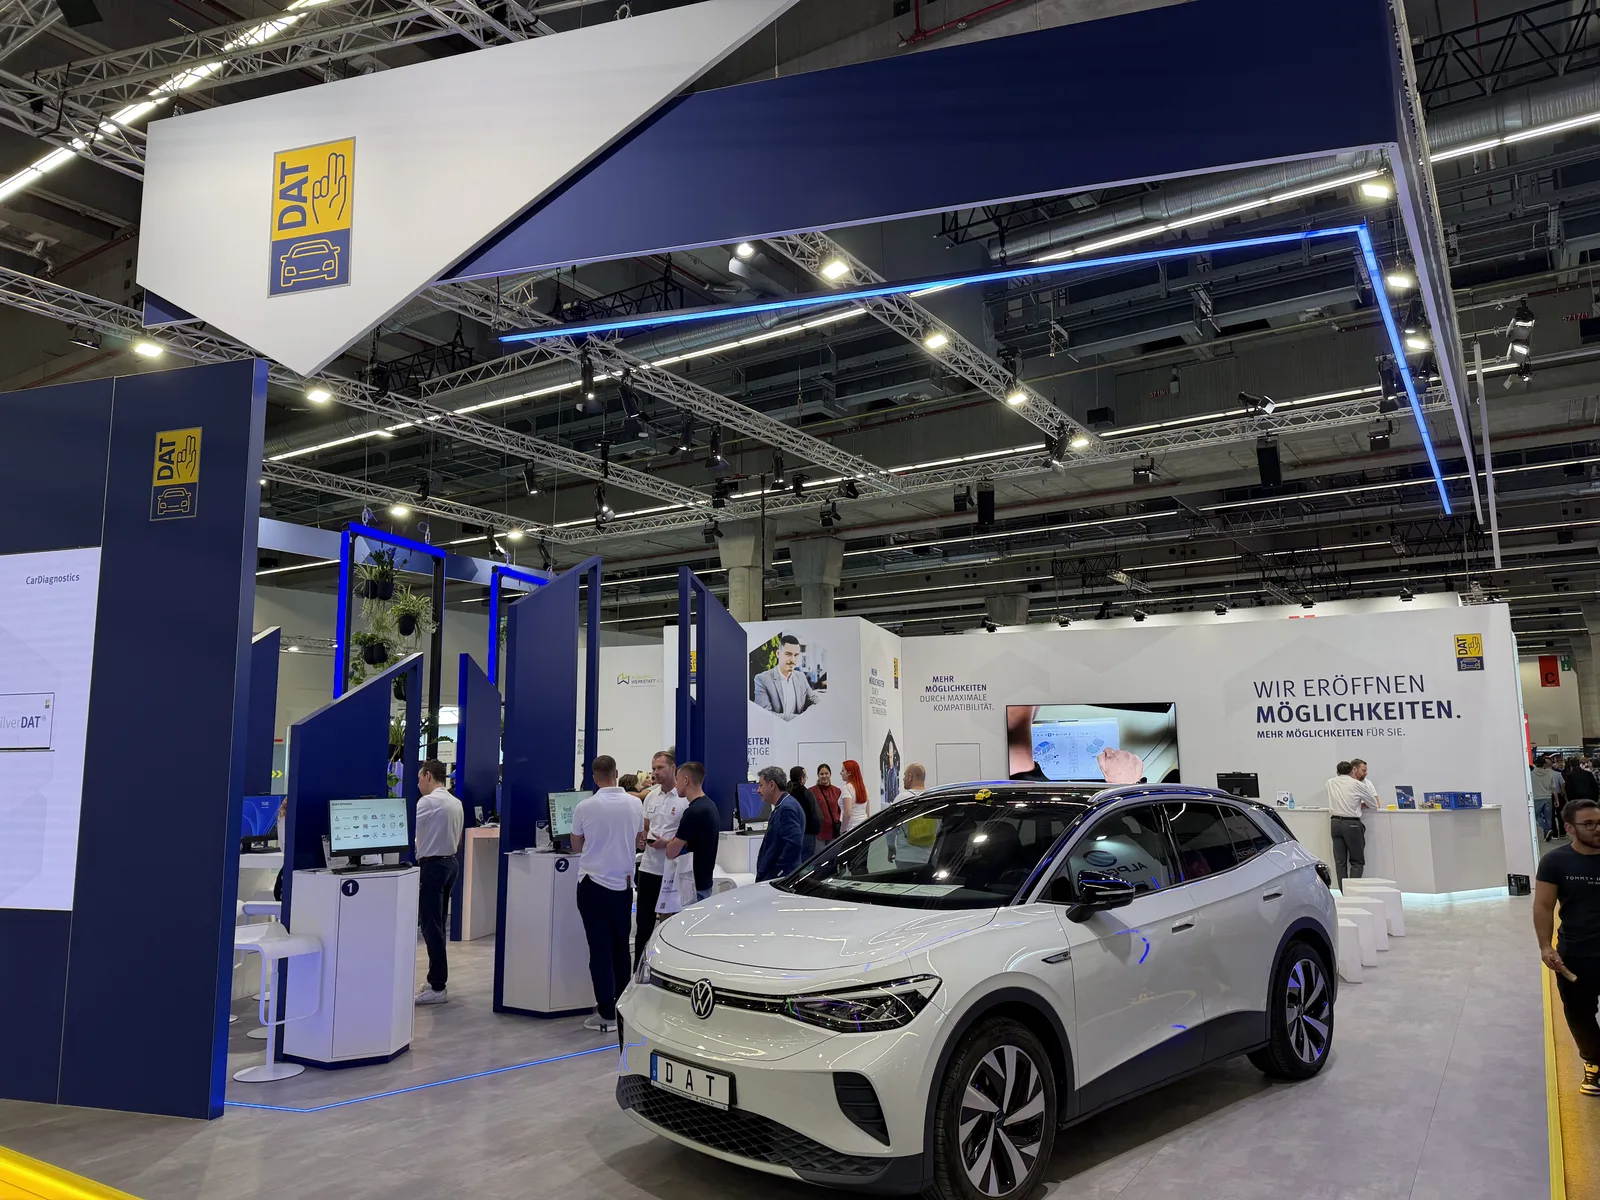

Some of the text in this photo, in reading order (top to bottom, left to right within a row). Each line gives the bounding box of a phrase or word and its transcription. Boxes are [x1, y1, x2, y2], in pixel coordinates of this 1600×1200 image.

[278, 161, 309, 231] DAT
[157, 438, 176, 480] DAT
[25, 573, 80, 585] CarDiagnostics
[1456, 637, 1468, 655] DAT
[1545, 671, 1556, 684] C
[925, 684, 987, 693] MÖGLICHKEITEN
[1253, 674, 1425, 699] WIR ERÖFFNEN
[920, 694, 987, 703] DURCH MAXIMALE
[933, 702, 995, 712] KOMPATIBILITÄT.
[1256, 700, 1461, 724] MÖGLICHKEITEN.
[1256, 727, 1406, 738] MEHR MÖGLICHKEITEN FÜR SIE.
[558, 860, 566, 870] 2
